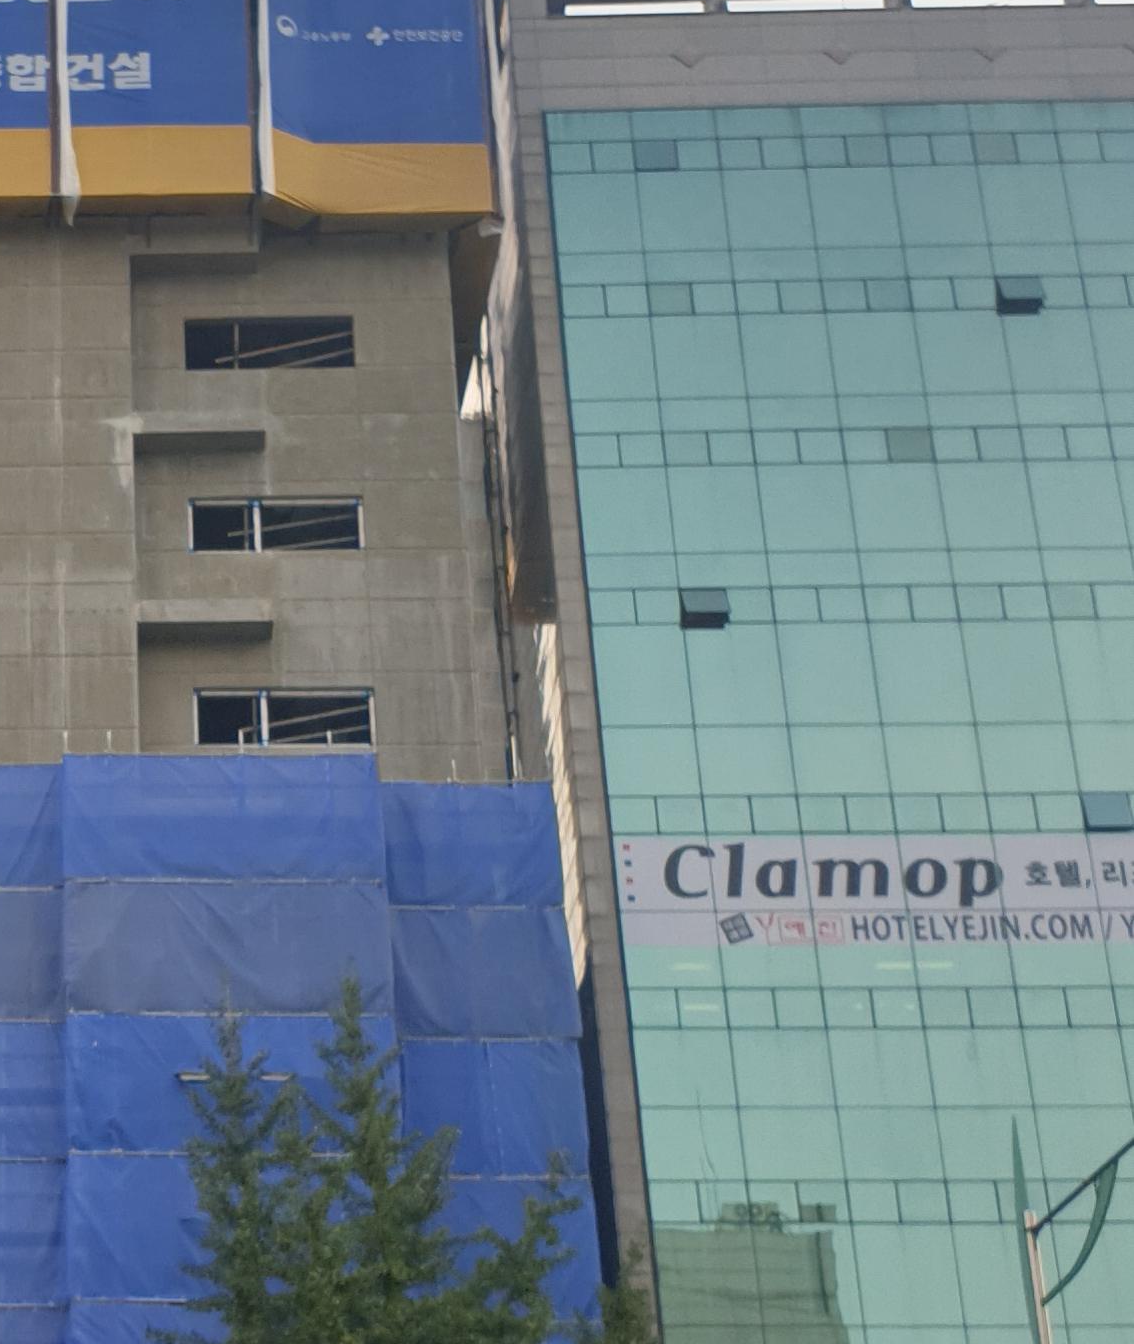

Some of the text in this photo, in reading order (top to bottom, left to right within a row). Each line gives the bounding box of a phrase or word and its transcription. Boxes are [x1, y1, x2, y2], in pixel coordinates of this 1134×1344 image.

[664, 843, 1004, 906] Clamop
[1101, 860, 1134, 887] 리
[850, 912, 1094, 941] HOTELYEJIN.COM
